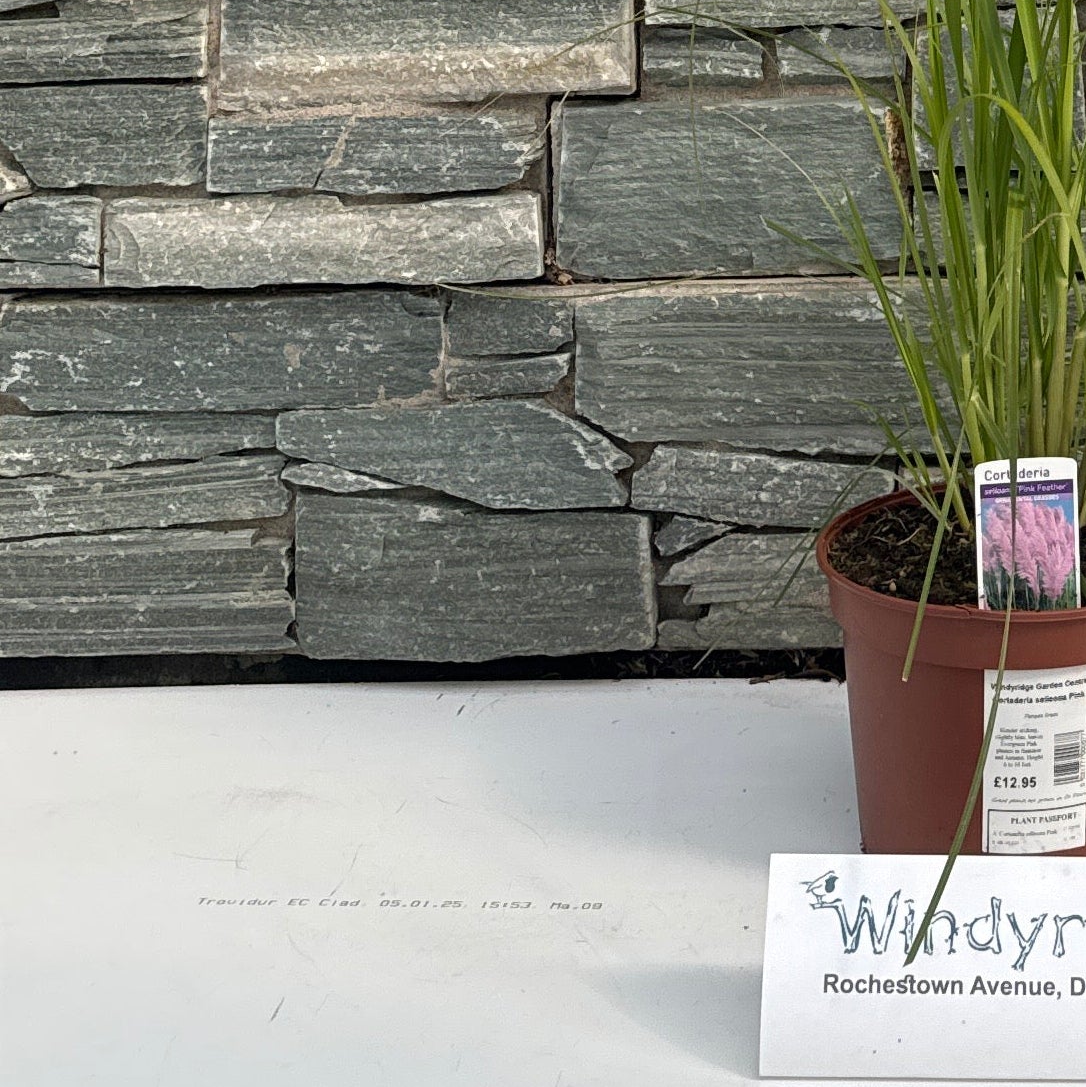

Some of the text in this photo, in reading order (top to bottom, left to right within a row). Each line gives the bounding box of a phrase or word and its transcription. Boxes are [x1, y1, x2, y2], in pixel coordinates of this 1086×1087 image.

[984, 467, 1050, 482] Cortderia
[992, 696, 1033, 704] ortaderia
[1068, 690, 1085, 700] Pink
[993, 776, 1037, 789] £12.95
[1010, 816, 1037, 825] PLANT
[287, 898, 310, 907] EC
[822, 973, 965, 998] Rochestown
[969, 975, 1062, 1001] Avenue,
